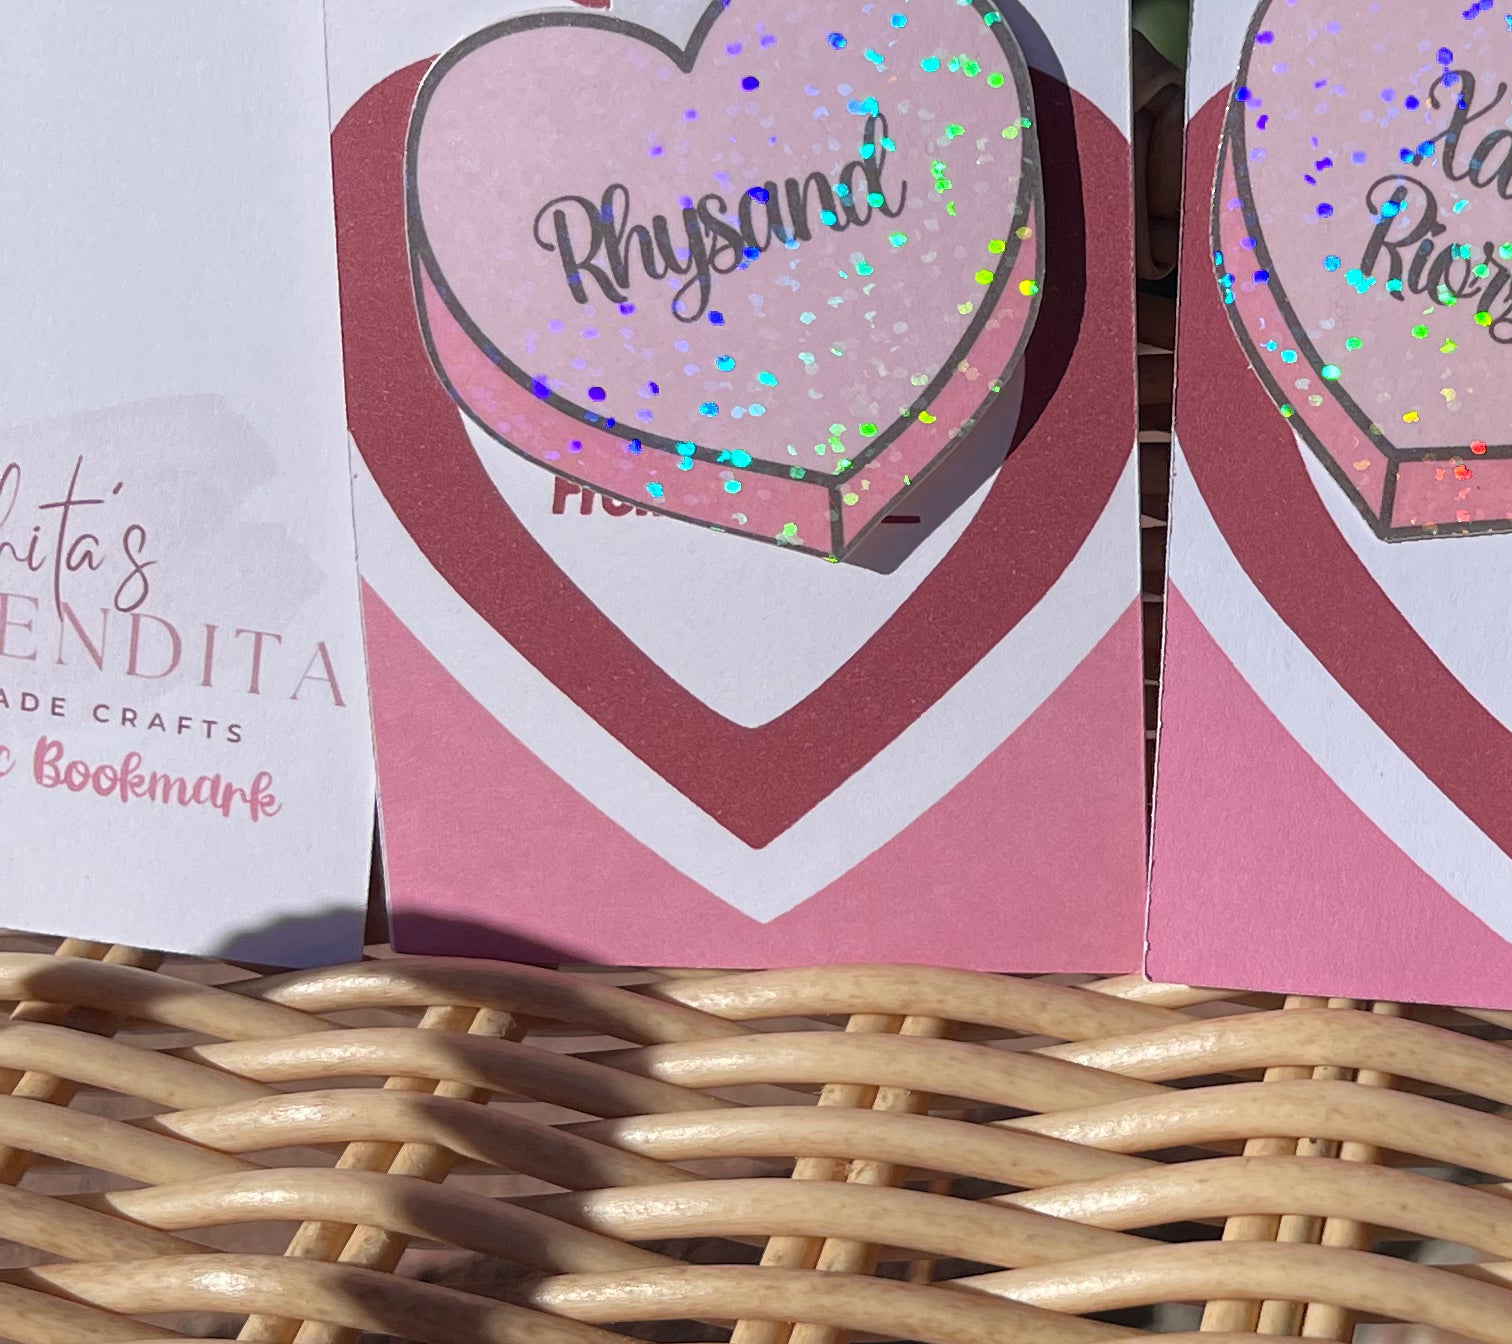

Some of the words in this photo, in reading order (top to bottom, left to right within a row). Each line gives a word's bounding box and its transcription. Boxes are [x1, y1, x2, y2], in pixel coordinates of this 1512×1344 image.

[533, 112, 908, 324] Rhysand
[92, 704, 242, 744] CRAFTS
[33, 735, 284, 823] Bookmark
